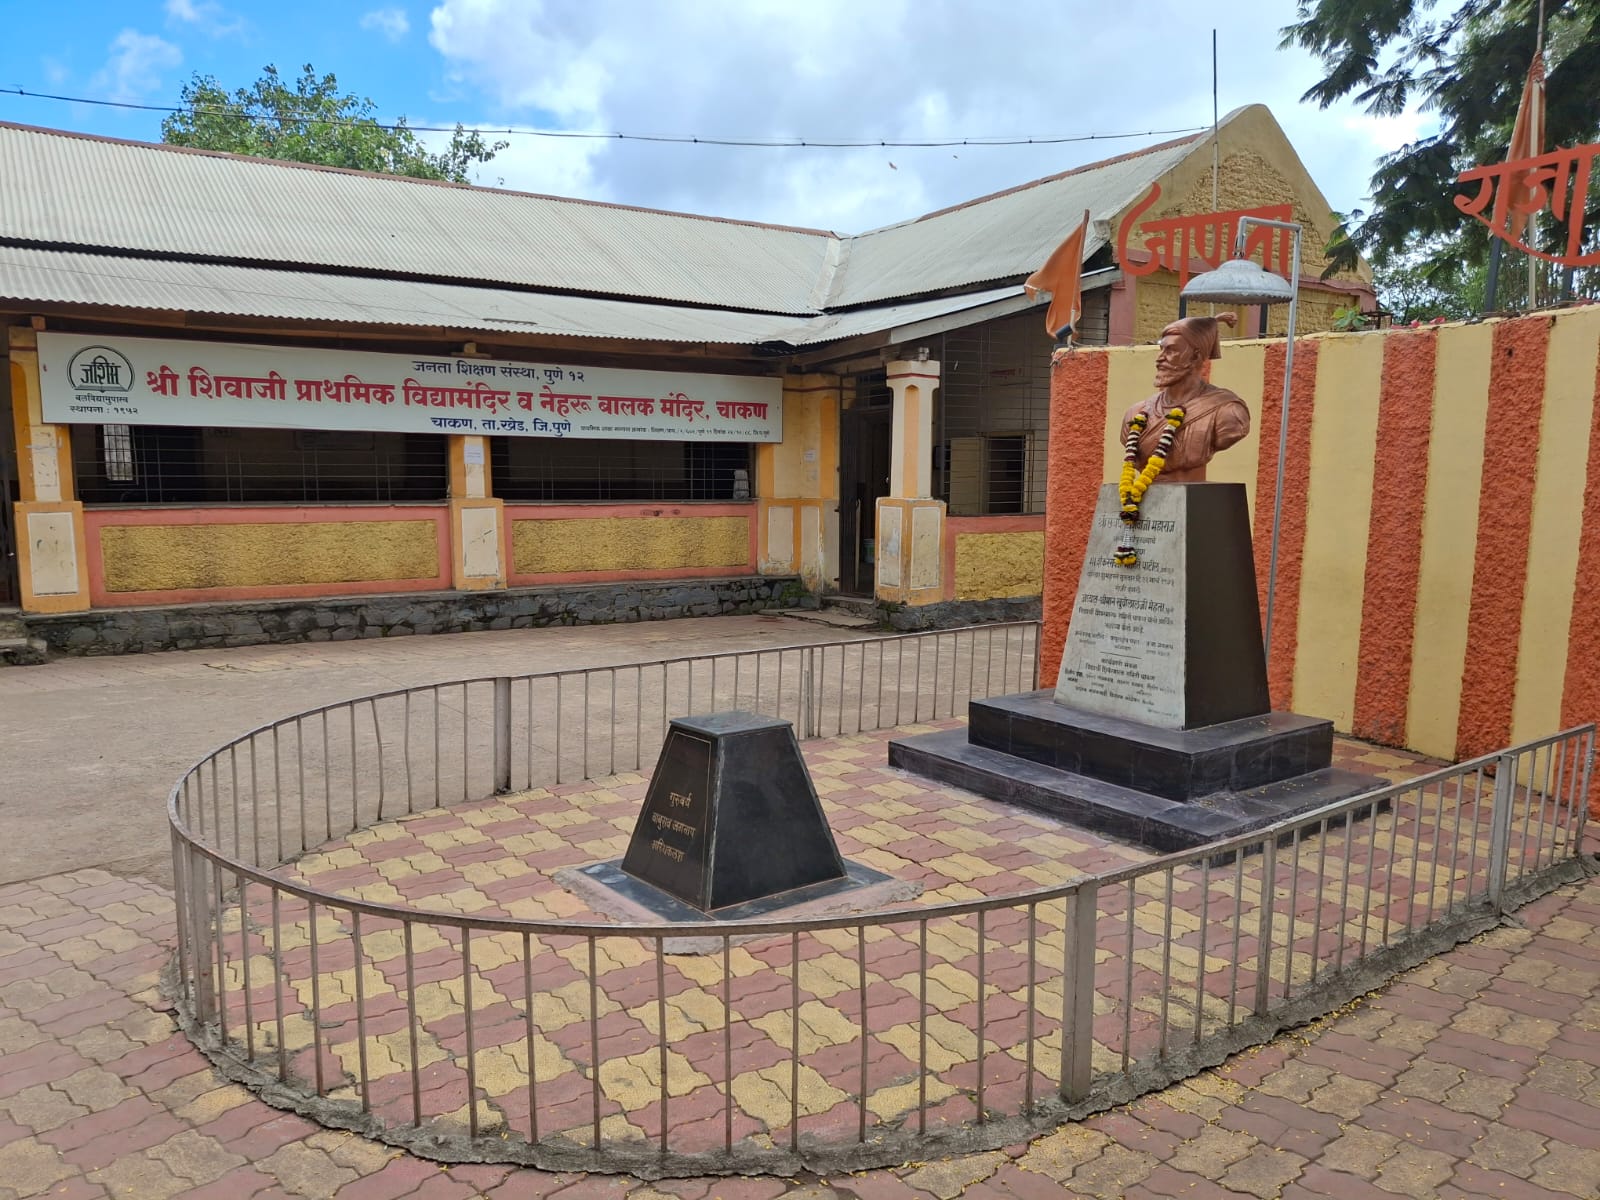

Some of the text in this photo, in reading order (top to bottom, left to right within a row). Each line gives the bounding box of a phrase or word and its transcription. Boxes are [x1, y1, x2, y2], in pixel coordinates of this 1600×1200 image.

[411, 359, 585, 385] जनता शिक्षण संस्था, पुणे १२
[147, 365, 768, 421] श्री शिवाजी प्राथमिक विद्यामंदिर व नेहरू बालक मंदिर, चाकण
[70, 405, 104, 414] स्थापना
[113, 406, 139, 415] १९५२
[431, 416, 572, 437] चाकण, ता.खेड, जि.पुणे
[669, 792, 693, 809] गुरुवर्य
